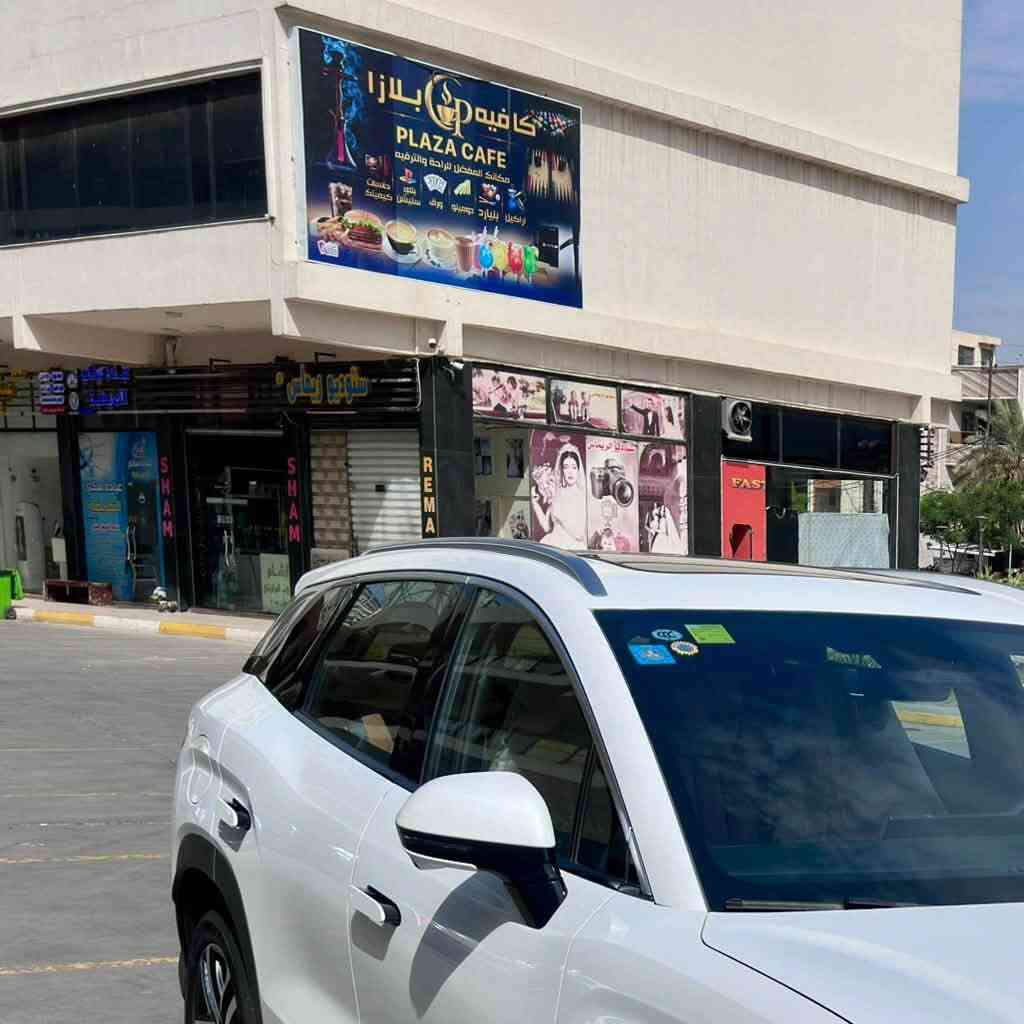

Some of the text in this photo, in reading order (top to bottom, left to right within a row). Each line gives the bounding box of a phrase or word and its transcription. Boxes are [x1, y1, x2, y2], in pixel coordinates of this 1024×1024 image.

[367, 70, 537, 136] كافيه بلازا
[395, 126, 507, 169] PLAZA CAFE
[160, 456, 174, 537] SHAM
[287, 457, 302, 542] SHAM
[423, 456, 436, 535] REMA
